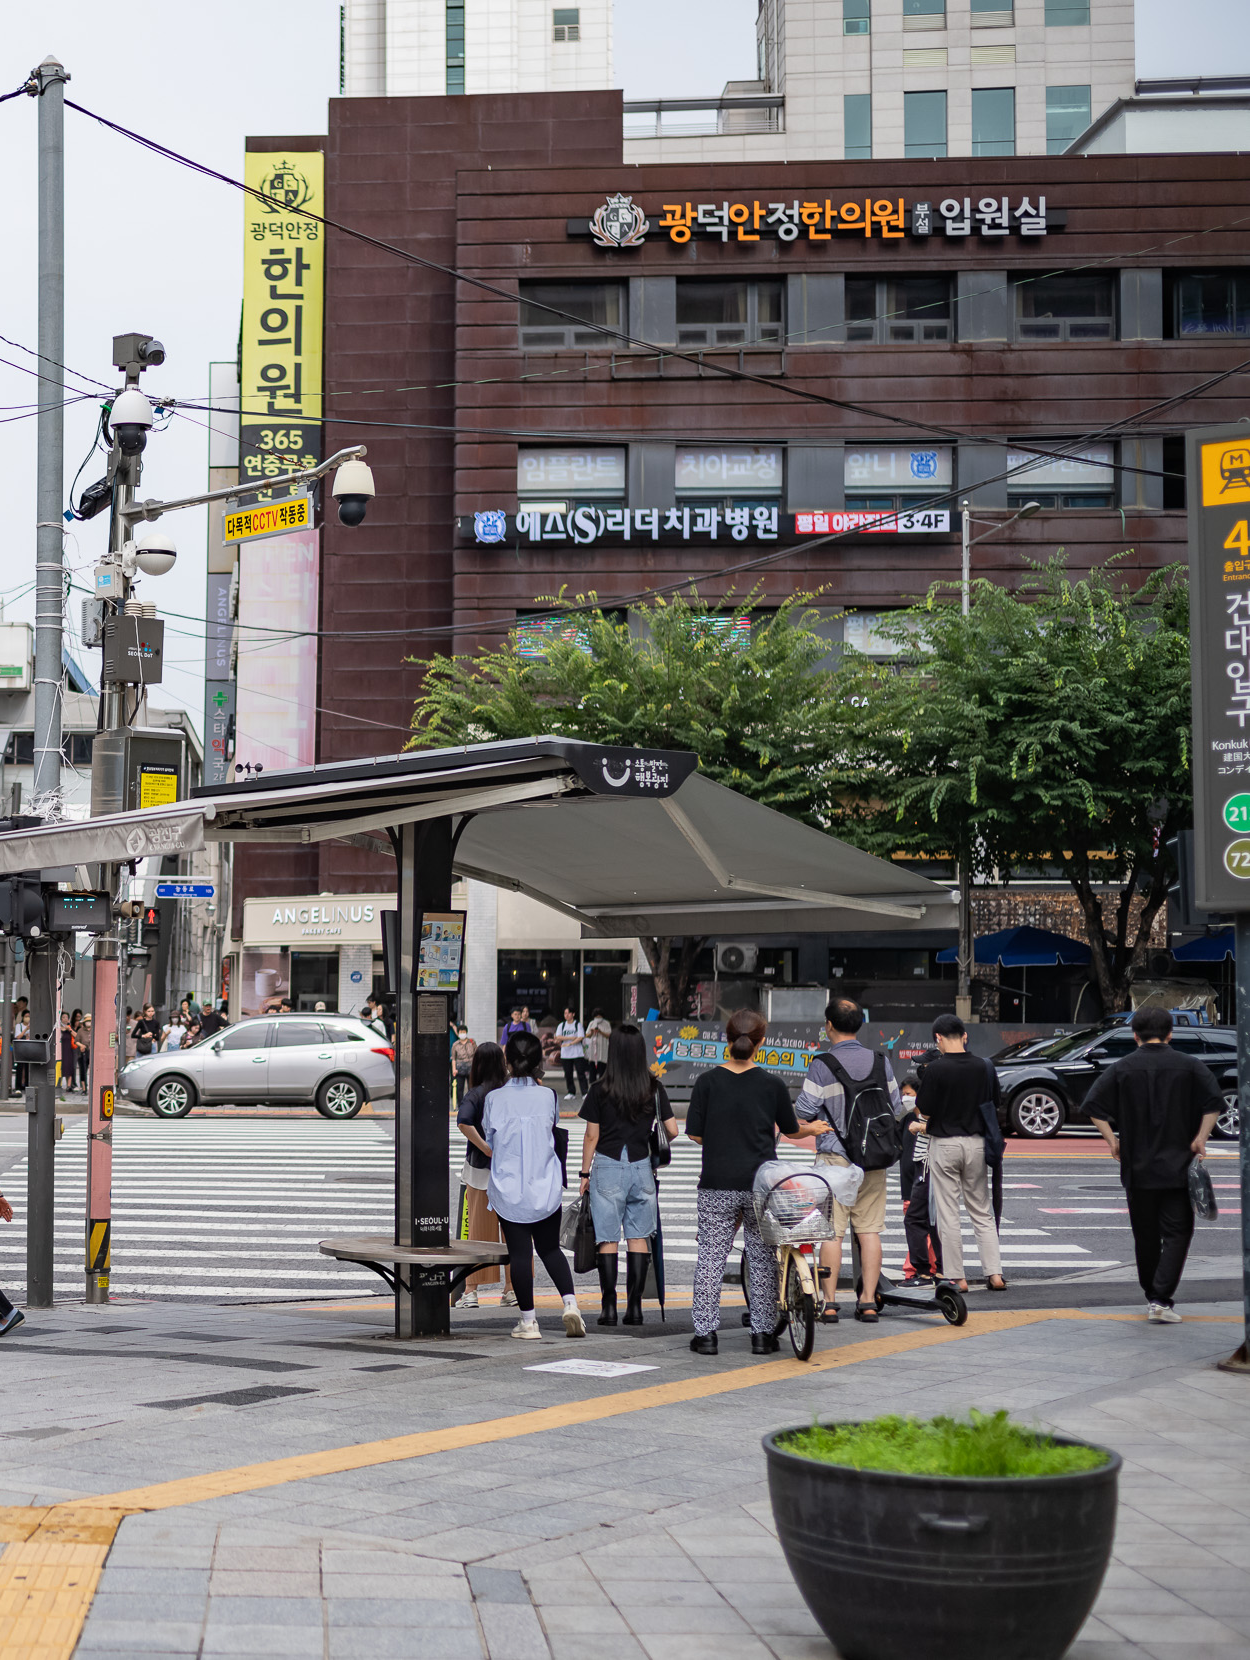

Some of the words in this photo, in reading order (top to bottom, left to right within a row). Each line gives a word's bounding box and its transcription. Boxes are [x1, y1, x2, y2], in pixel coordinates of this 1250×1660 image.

[915, 203, 930, 234] 부설
[939, 196, 1047, 236] 입원실
[250, 221, 319, 241] 광덕안정
[257, 247, 311, 416] 한의원
[258, 429, 304, 450] 365
[522, 455, 620, 483] 임플란트
[680, 453, 777, 479] 치아교정
[847, 453, 896, 479] 앞니
[1223, 519, 1250, 556] 4
[216, 587, 228, 668] ANGELINUS
[1212, 739, 1249, 751] Konkuk
[213, 772, 225, 782] 2F
[1229, 806, 1250, 821] 21
[149, 826, 182, 842] 광진구
[175, 885, 195, 893] 능동로
[272, 904, 375, 924] ANGELINUS
[676, 1042, 717, 1059] 능동로
